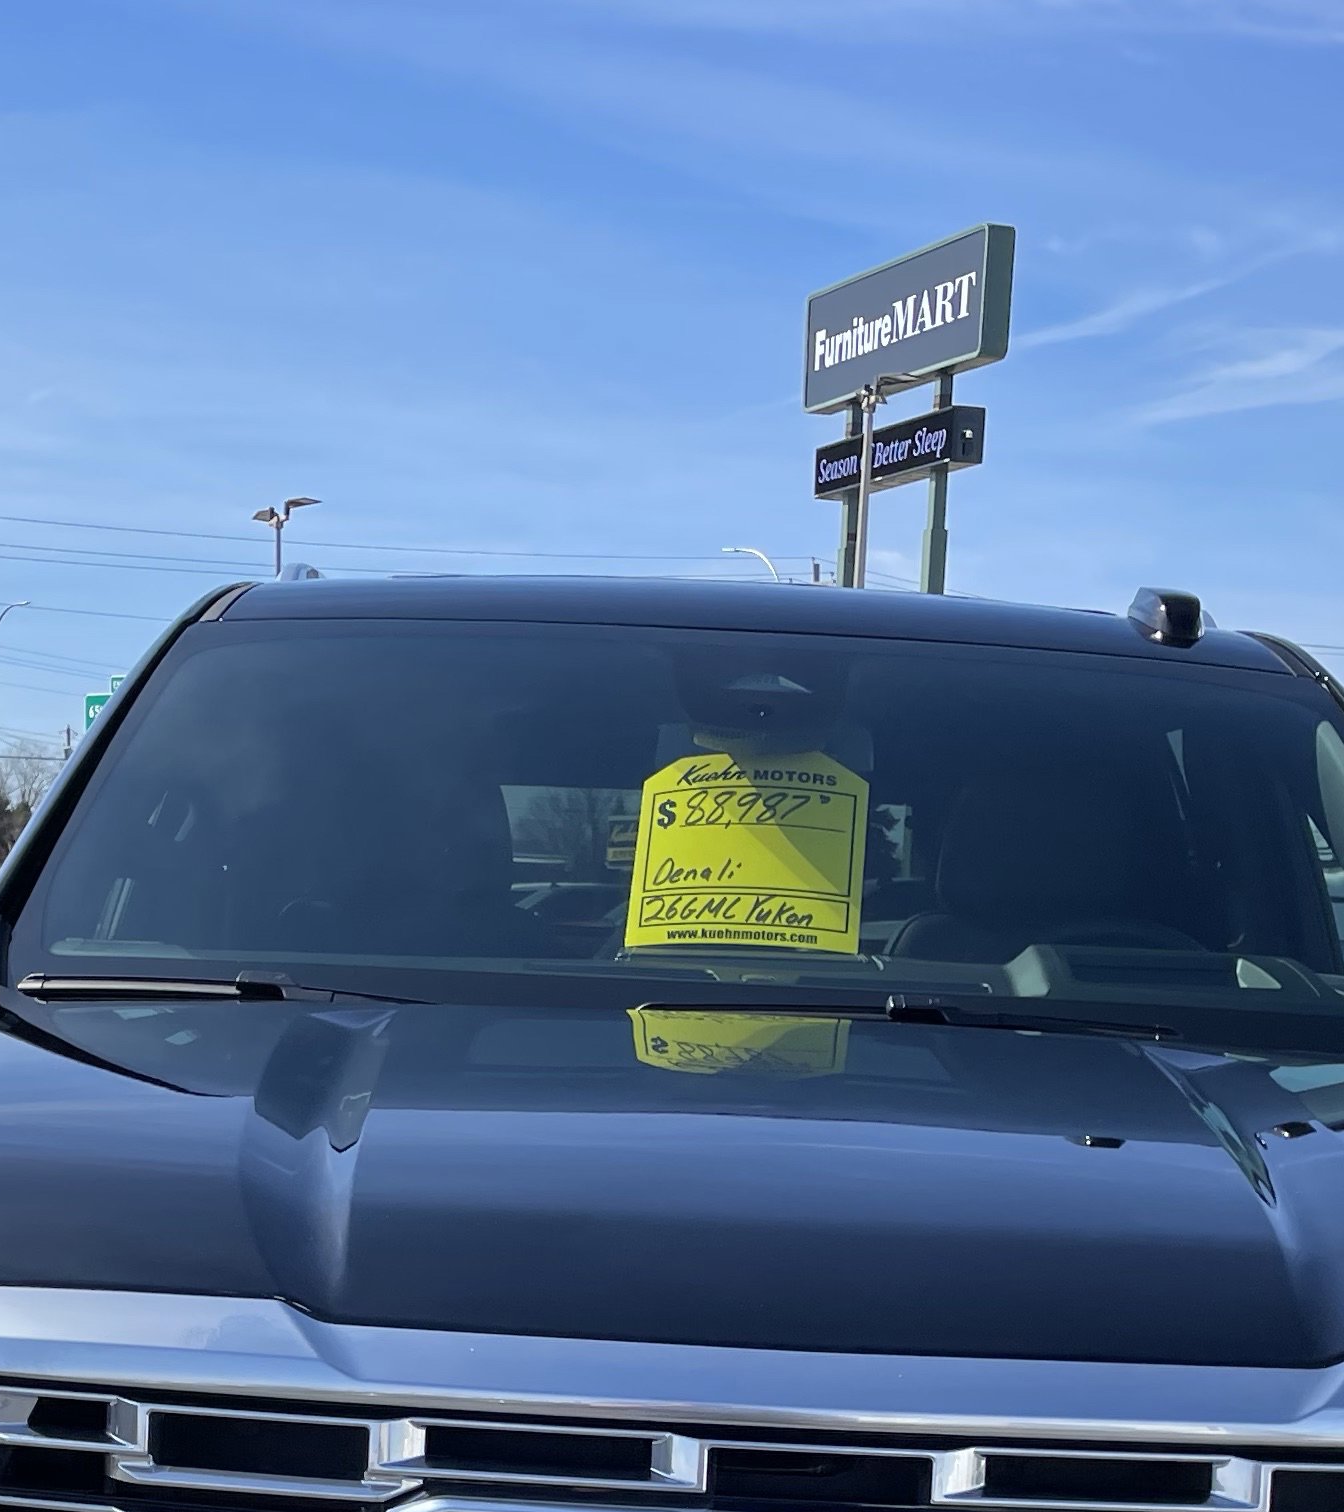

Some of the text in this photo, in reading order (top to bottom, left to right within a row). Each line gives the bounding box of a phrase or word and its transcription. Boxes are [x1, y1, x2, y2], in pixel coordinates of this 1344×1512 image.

[818, 455, 858, 484] Season
[873, 438, 912, 469] Better
[912, 426, 948, 459] Sleep
[677, 763, 838, 787] Kuehn MOTORS
[653, 857, 743, 887] Denali
[666, 928, 818, 945] www.kuehnmotors.com
